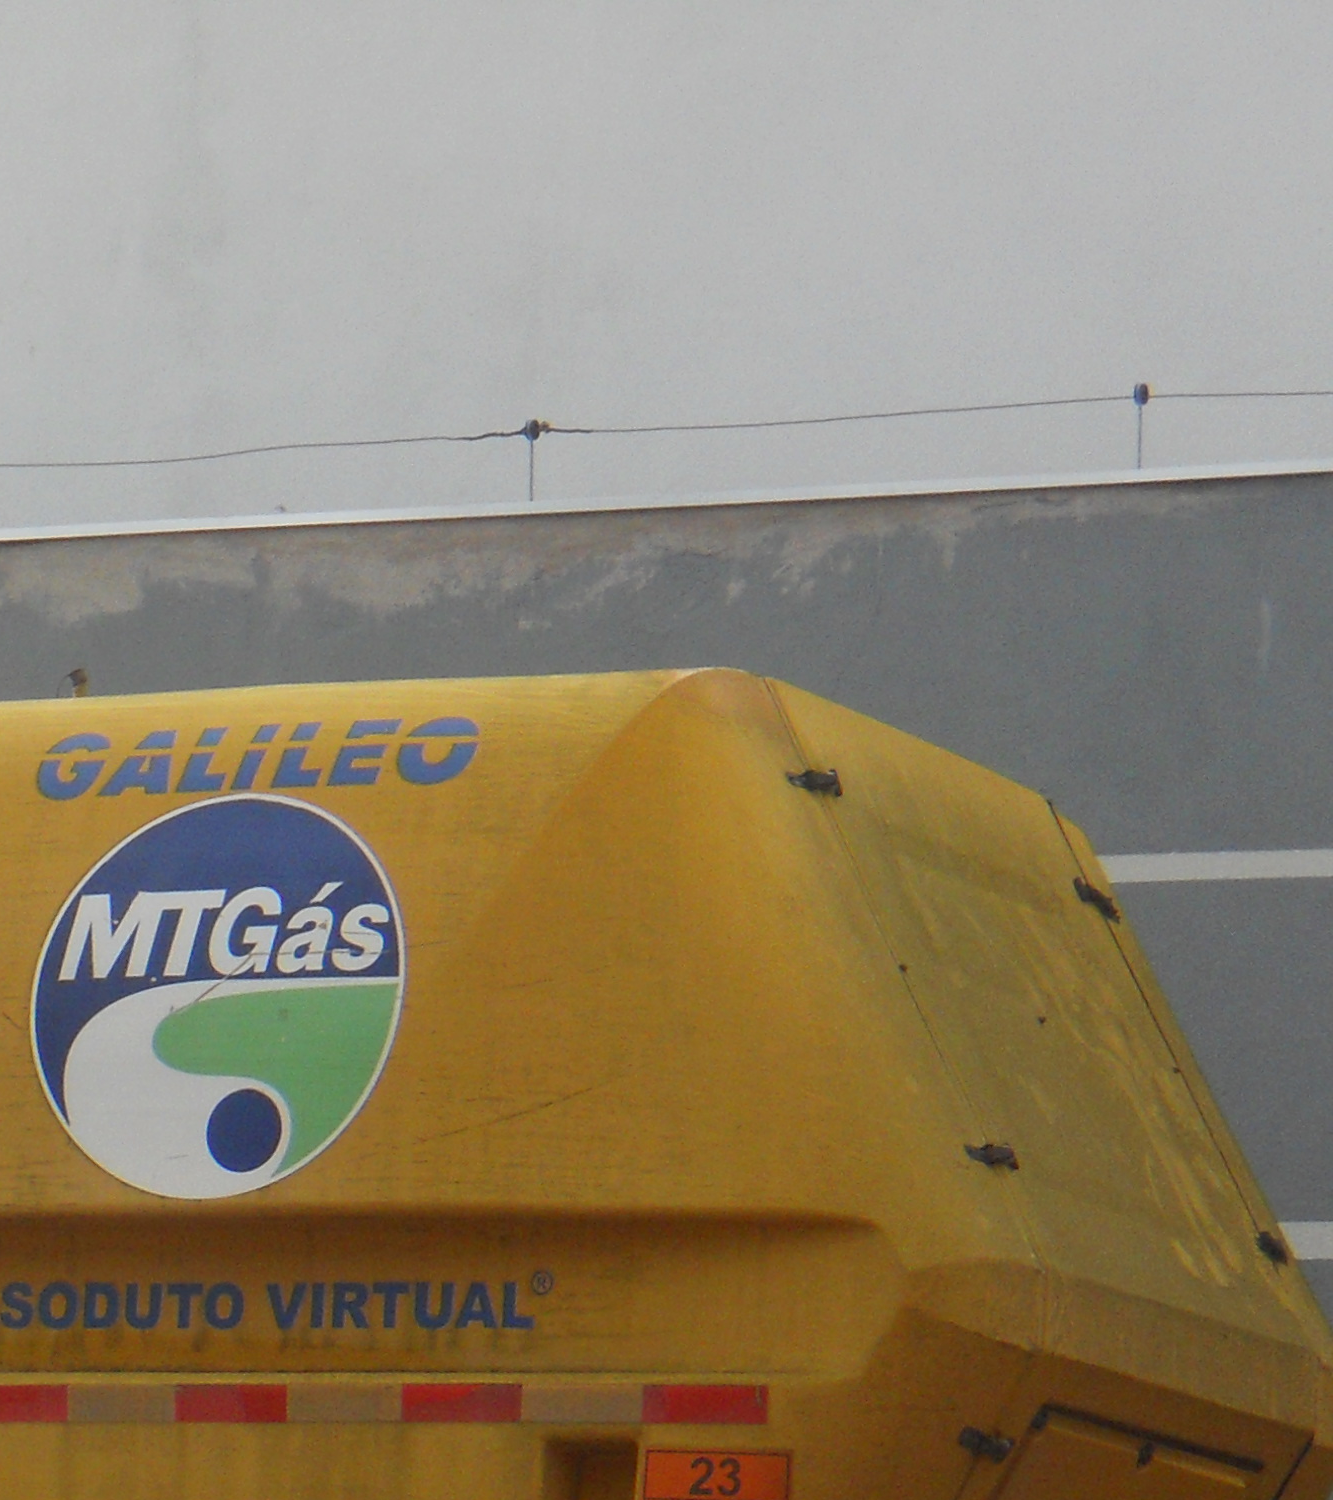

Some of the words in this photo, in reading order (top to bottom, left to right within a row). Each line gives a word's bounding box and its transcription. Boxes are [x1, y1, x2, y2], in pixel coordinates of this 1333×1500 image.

[36, 716, 480, 801] GALILEO
[58, 881, 389, 981] MTGás
[689, 1457, 742, 1496] 23
